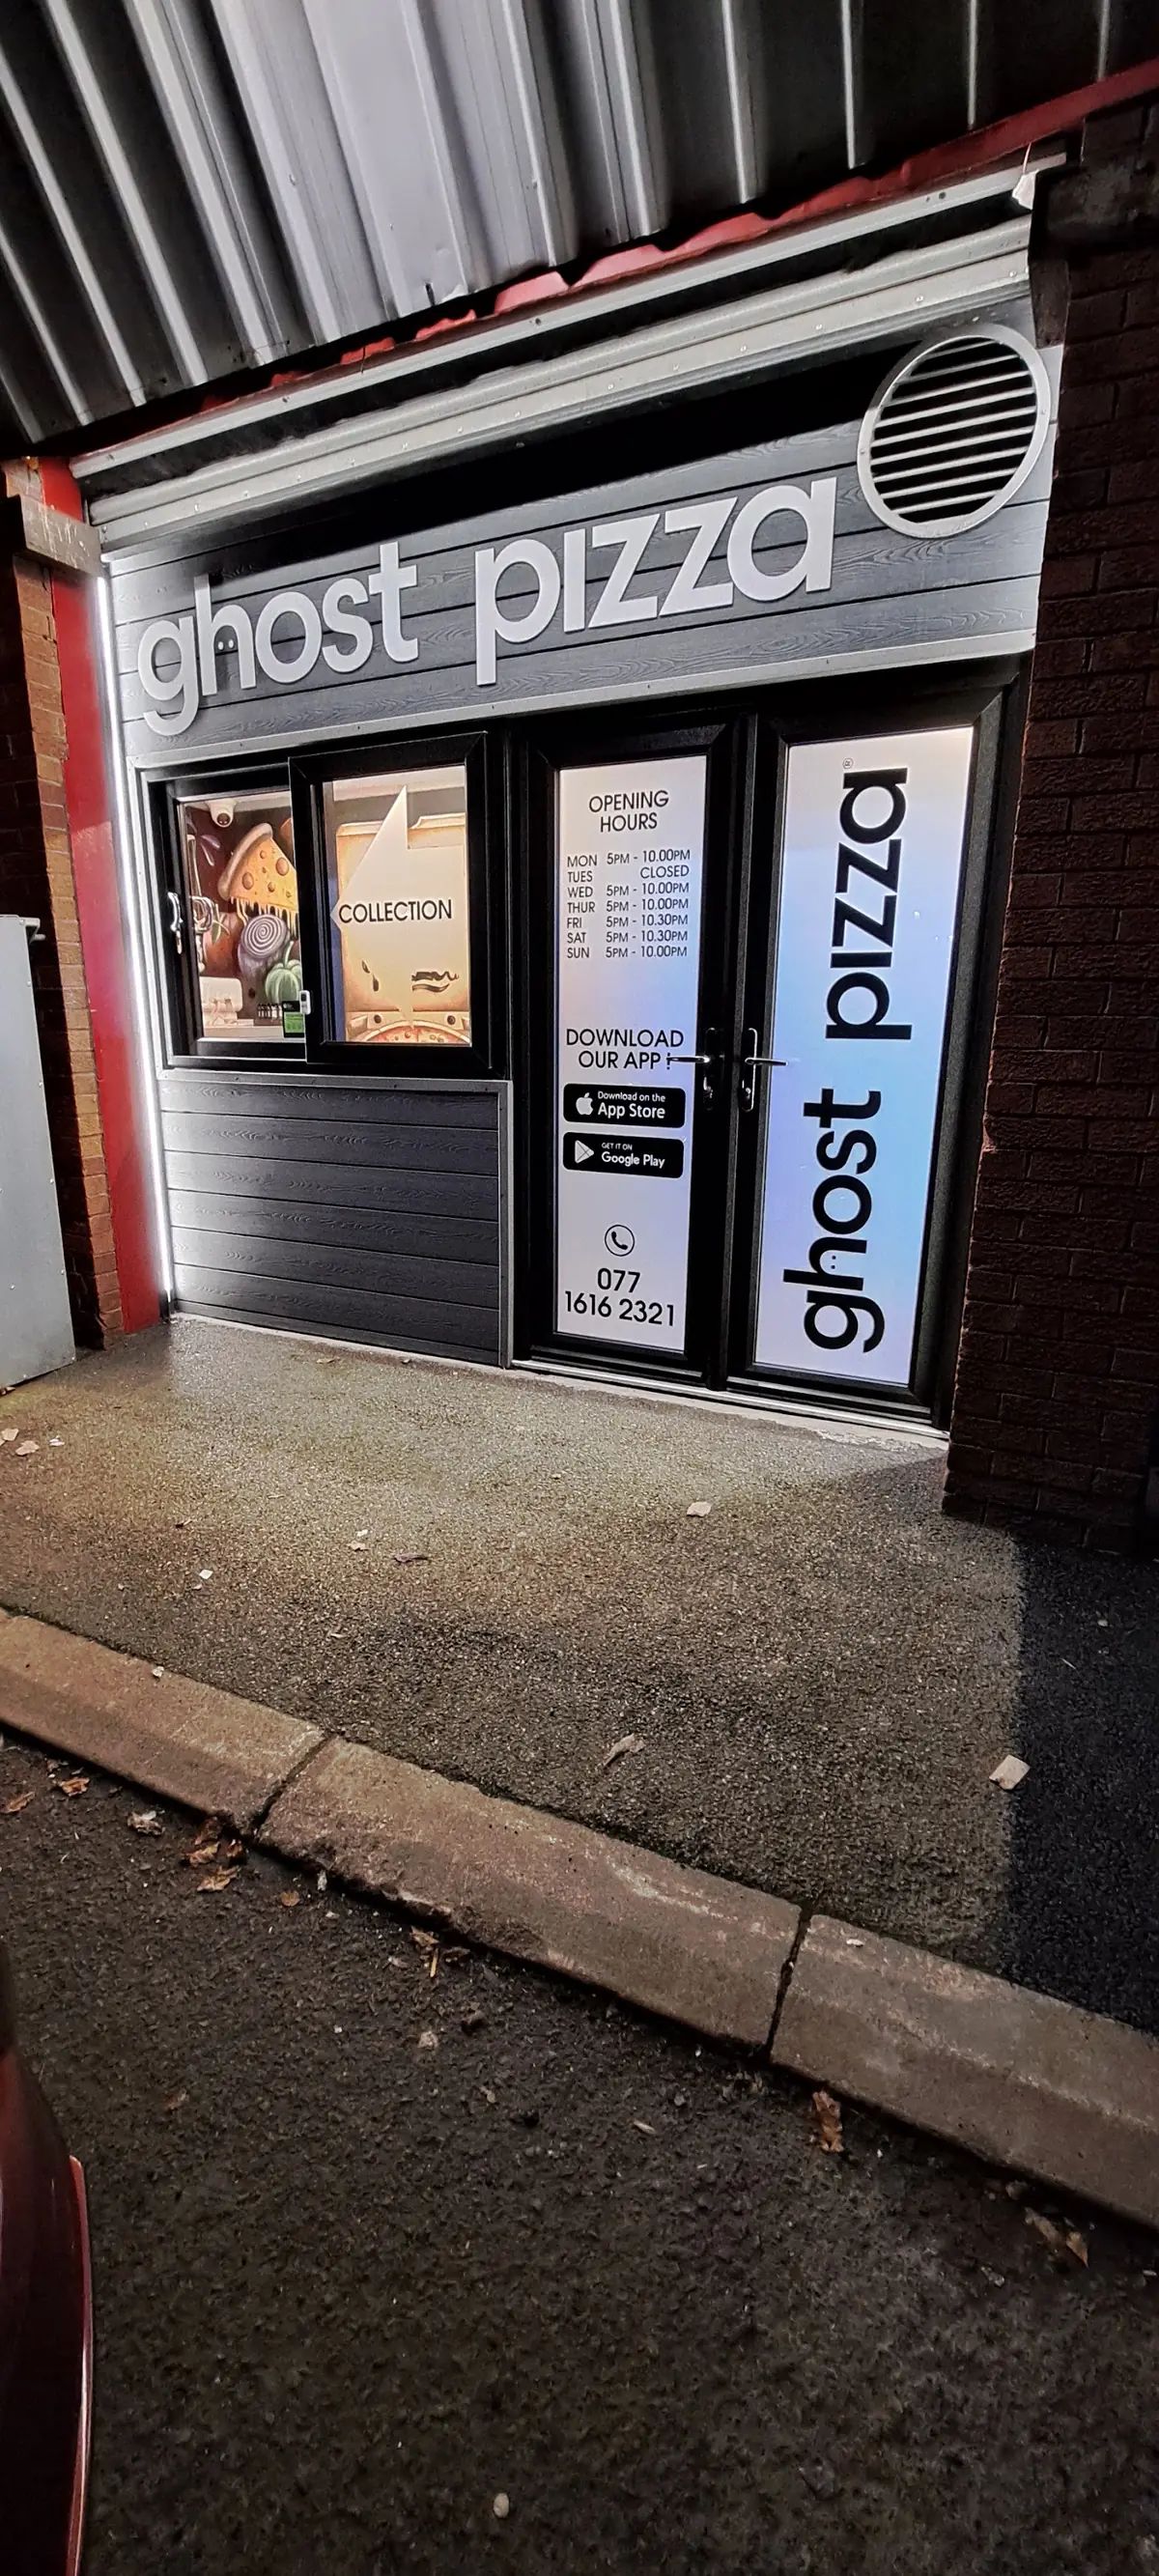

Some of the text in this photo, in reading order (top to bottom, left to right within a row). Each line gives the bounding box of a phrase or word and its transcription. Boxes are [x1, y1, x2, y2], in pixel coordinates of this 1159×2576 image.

[137, 477, 837, 737] ghost pizza
[589, 790, 669, 813] OPENING
[601, 812, 658, 833] HOURS
[567, 855, 597, 867] MON
[607, 853, 629, 864] 5PM
[642, 849, 691, 863] 10.00PM
[568, 864, 690, 883] TUES CLOSED
[568, 886, 593, 898] WED
[607, 885, 629, 896] 5PM
[642, 882, 690, 894] 10.00PM
[339, 899, 453, 923] COLLECTION
[568, 902, 595, 914] THUR
[607, 901, 629, 912] 5PM
[642, 898, 689, 911] 10.00PM
[567, 918, 582, 928] FRI
[607, 917, 629, 928] 5PM
[641, 914, 689, 926] 10.30PM
[567, 932, 586, 944] SAT
[606, 931, 629, 943] 5PM
[641, 930, 688, 942] 10.30PM
[567, 947, 590, 959] SUN
[606, 947, 628, 958] 5PM
[640, 946, 688, 957] 10.00PM
[566, 1029, 684, 1048] DOWNLOAD
[578, 1051, 618, 1069] OUR
[623, 1051, 661, 1069] APP
[782, 766, 913, 1354] ghost pizza
[598, 1090, 637, 1101] Download
[652, 1093, 665, 1102] the
[598, 1102, 665, 1119] App Store
[602, 1151, 665, 1169] Google Play
[597, 1267, 641, 1293] 077
[564, 1290, 675, 1326] 1616 2321
